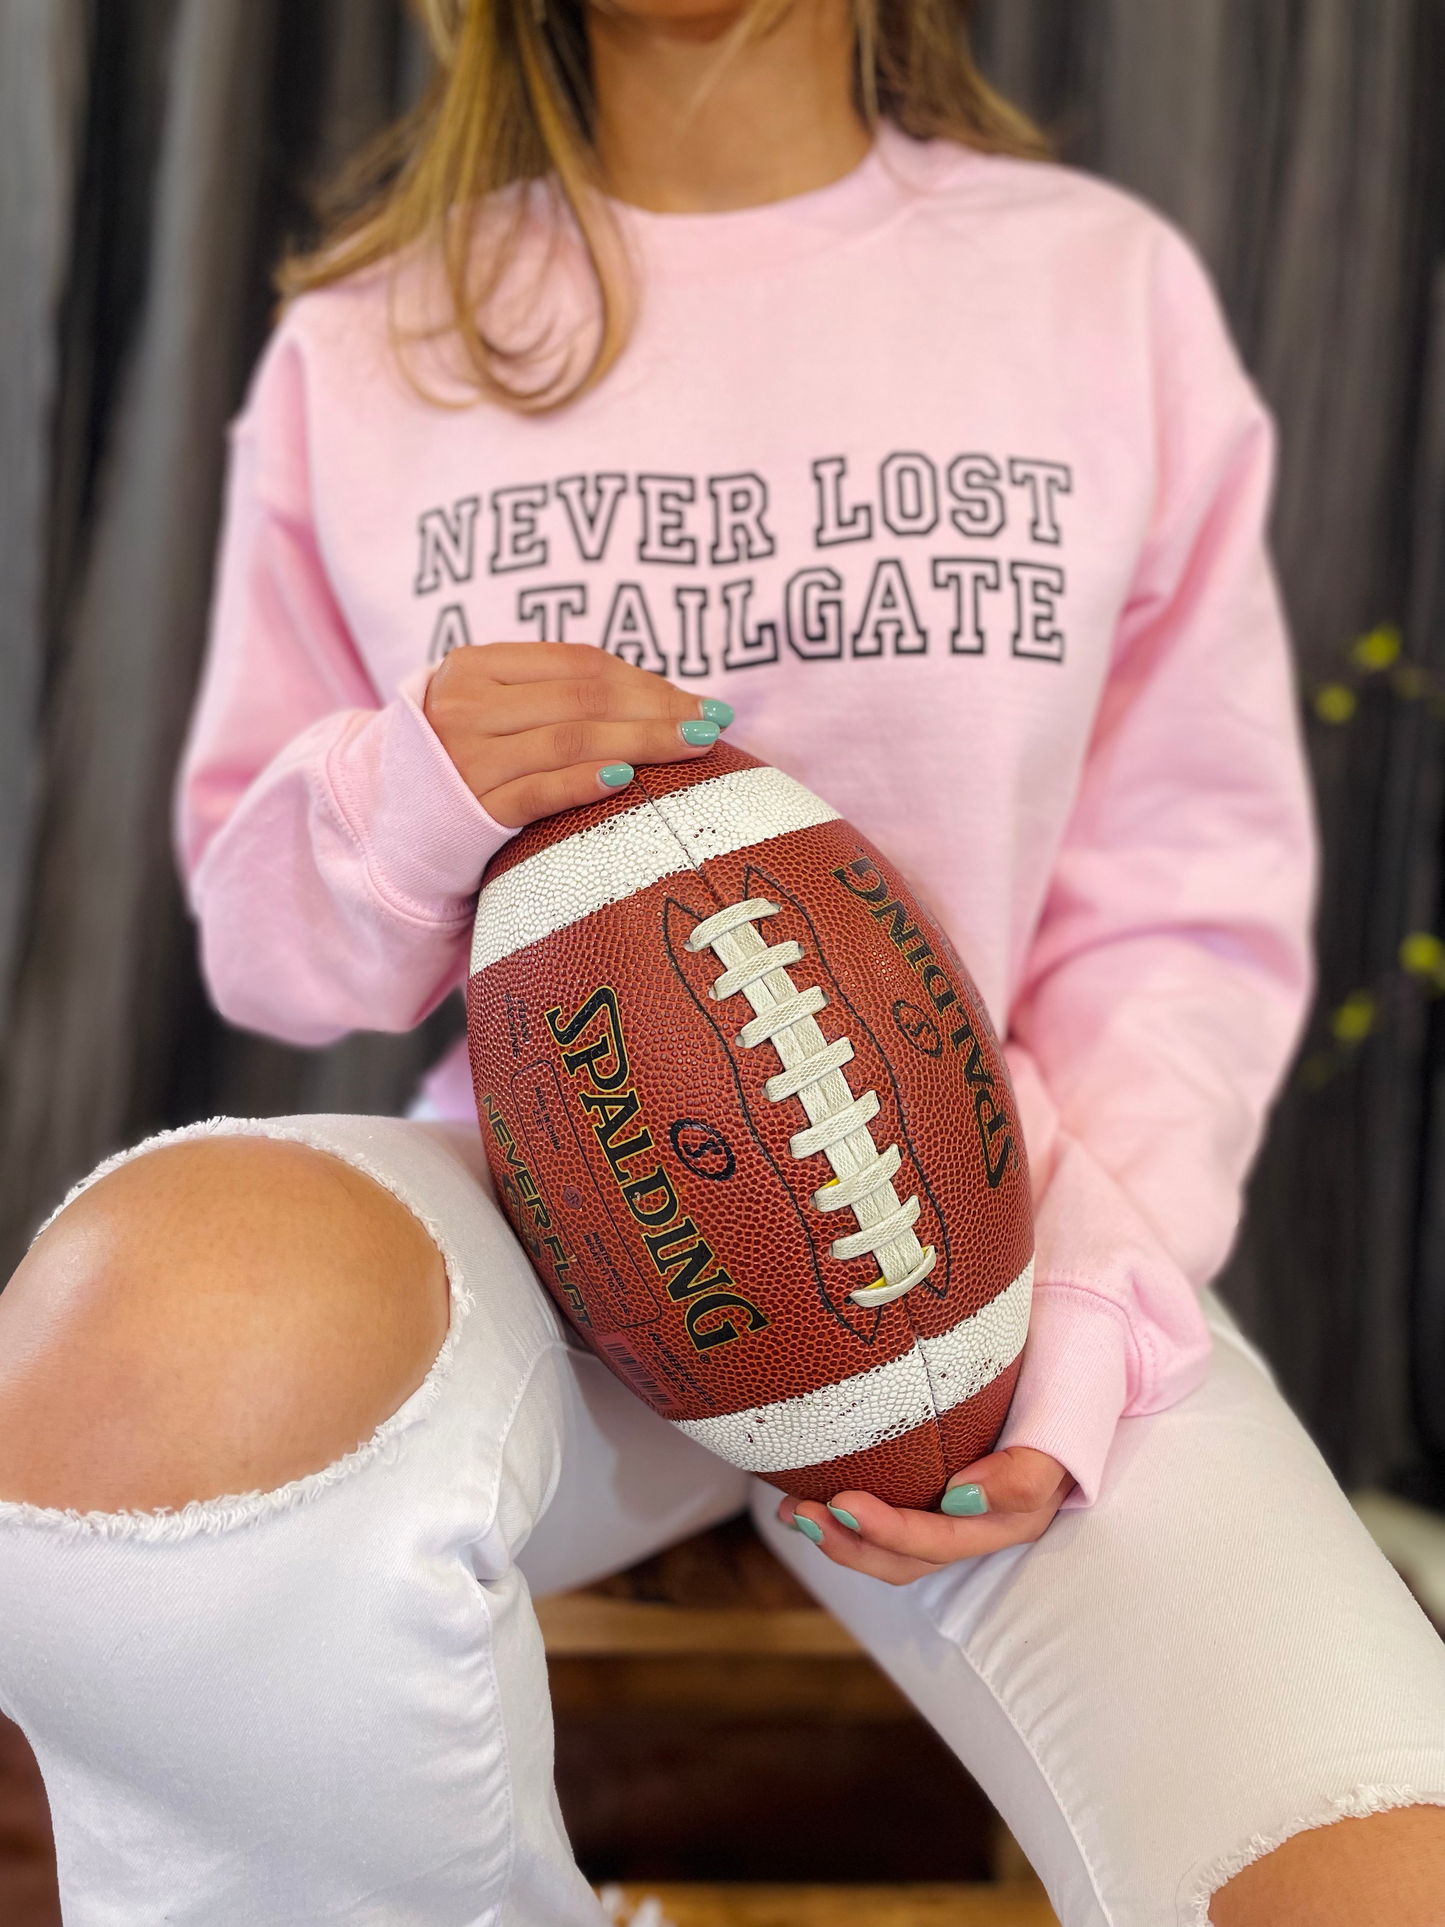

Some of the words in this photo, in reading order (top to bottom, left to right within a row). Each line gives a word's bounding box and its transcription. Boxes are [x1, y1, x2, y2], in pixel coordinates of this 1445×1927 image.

[415, 473, 775, 596] NEVER
[812, 452, 1072, 547] LOST
[518, 557, 1066, 679] TAILGATE
[831, 856, 1019, 1189] SPALDING
[534, 1086, 548, 1114] MADE
[546, 1123, 561, 1151] CHINA
[544, 985, 770, 1353] SPALDING
[482, 1093, 552, 1231] NEVER
[543, 1234, 593, 1329] FLAT
[583, 1234, 602, 1266] INFLATE
[591, 1232, 613, 1267] MOISTEN
[610, 1265, 630, 1296] NEEDLE
[648, 1332, 716, 1406] RUBBERIZED
